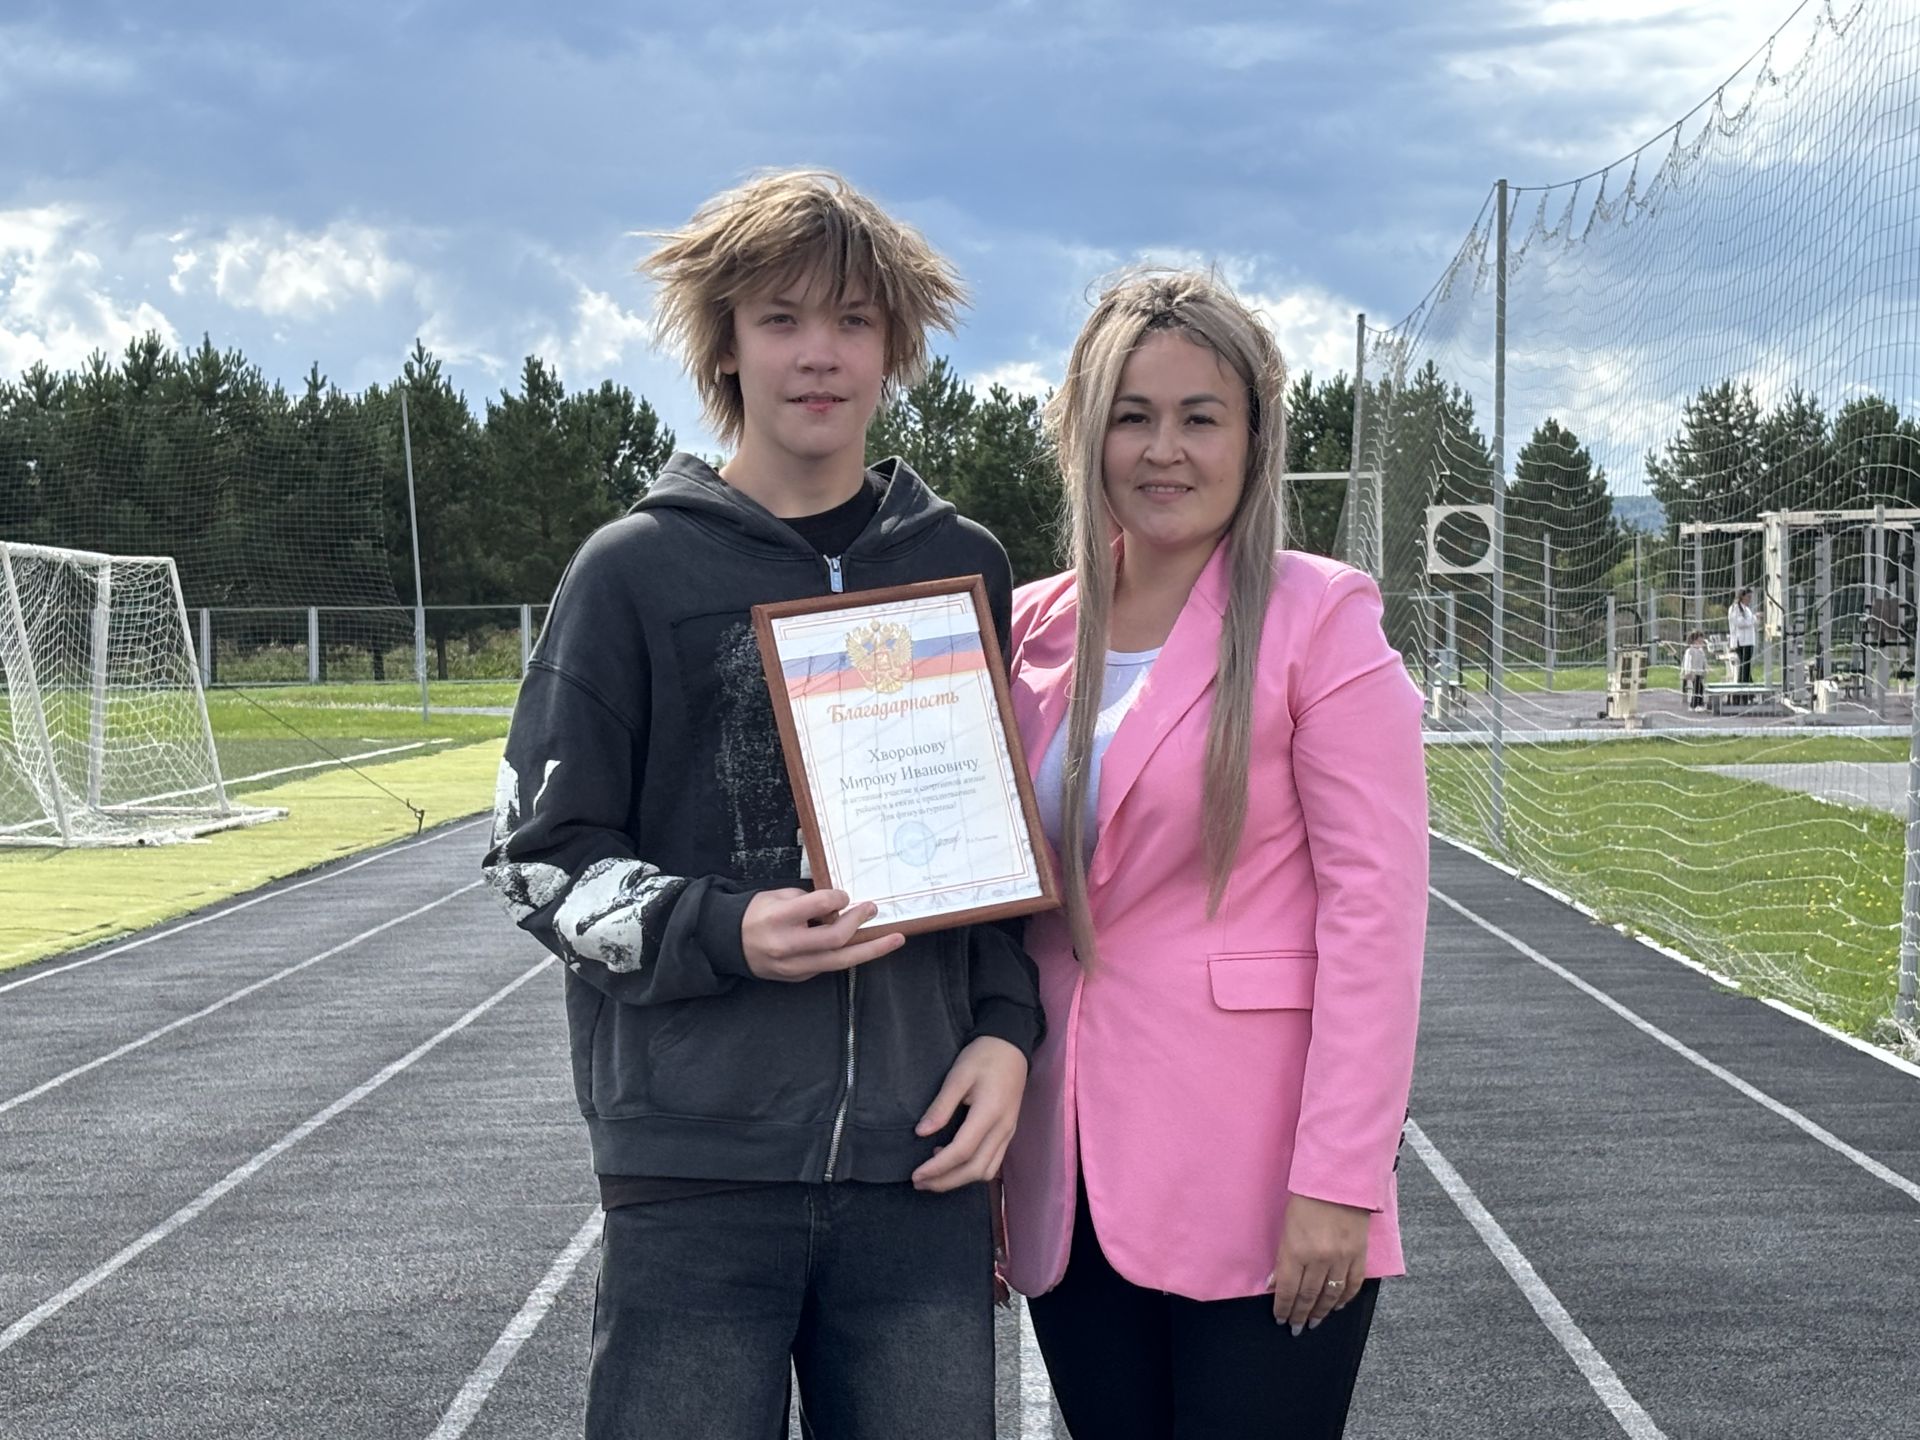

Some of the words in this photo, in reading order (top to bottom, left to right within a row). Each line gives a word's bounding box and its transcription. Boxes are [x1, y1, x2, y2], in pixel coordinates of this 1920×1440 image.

[826, 690, 960, 724] Благодарность
[868, 740, 947, 764] Хворонову
[840, 772, 897, 791] Мирону
[901, 757, 979, 780] Ивановичу
